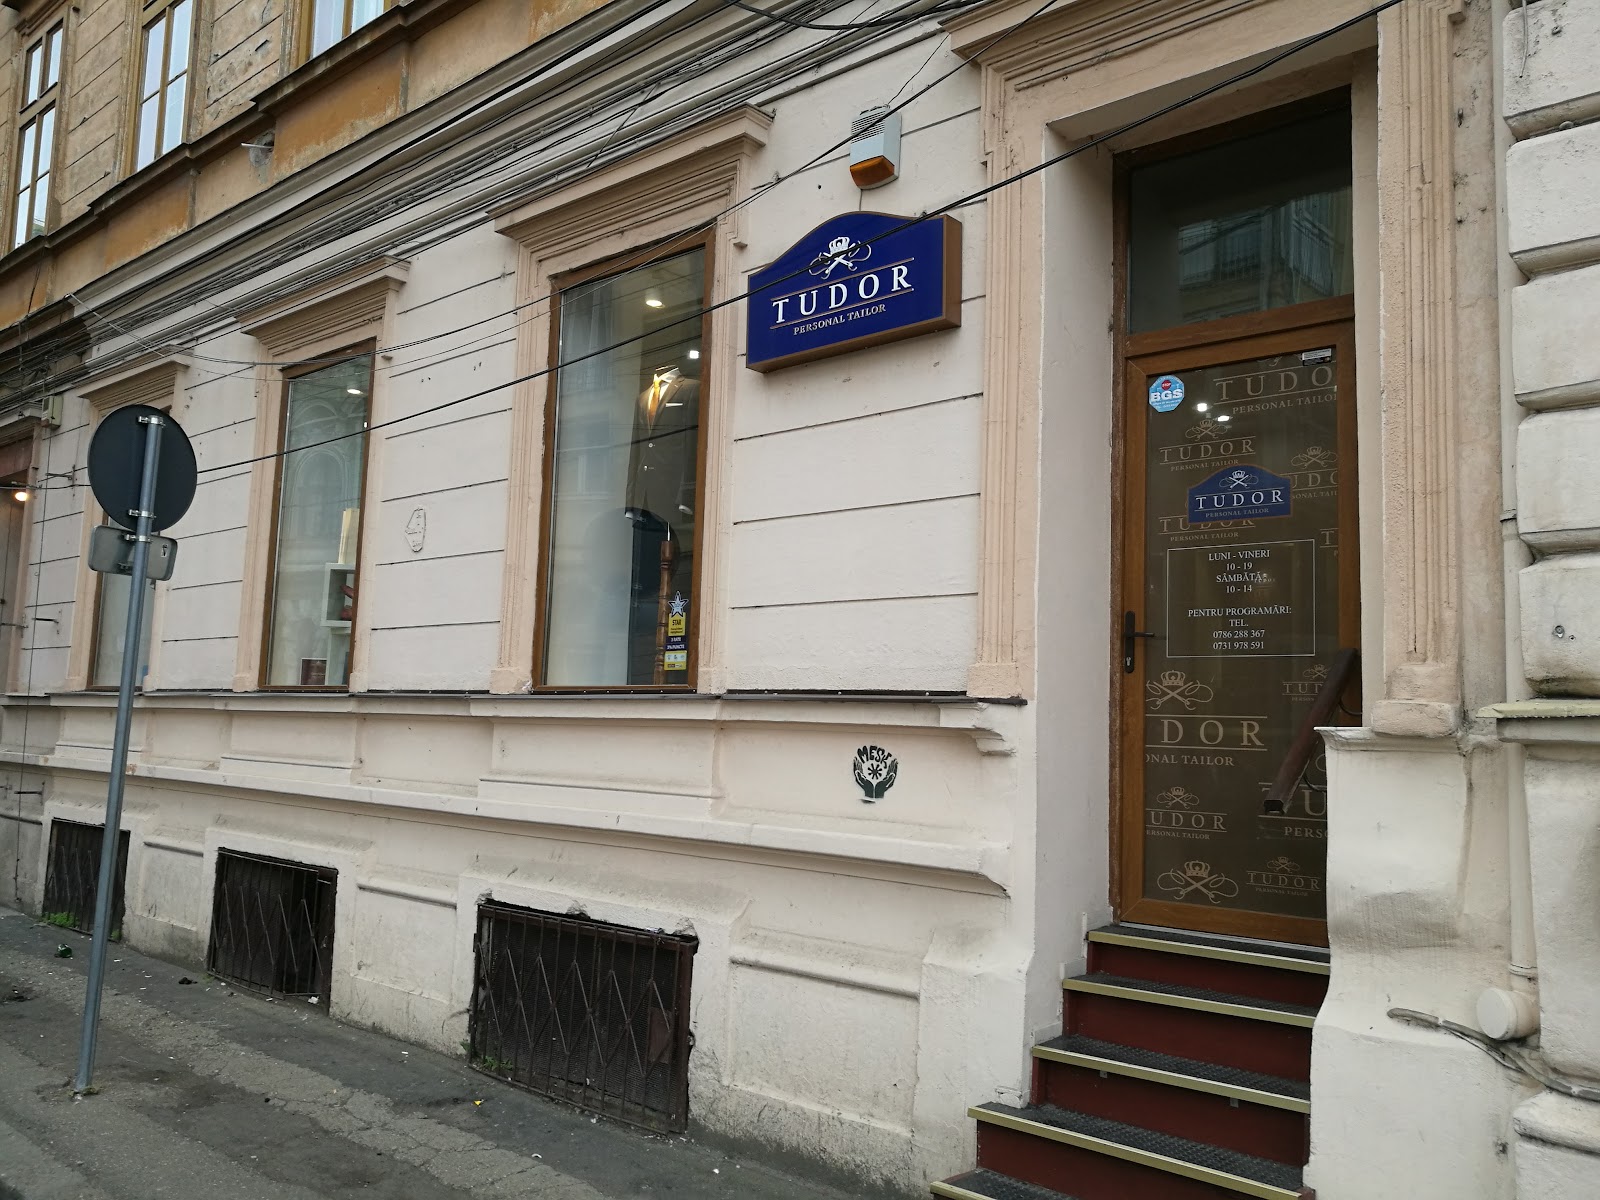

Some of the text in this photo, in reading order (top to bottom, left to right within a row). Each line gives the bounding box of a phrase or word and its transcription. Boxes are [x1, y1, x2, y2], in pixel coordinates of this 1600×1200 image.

[772, 265, 912, 324] TUDOR
[793, 303, 887, 336] PERSONAL TAILOR
[1150, 388, 1184, 403] BGS
[1232, 401, 1294, 415] PERSONAL
[1160, 439, 1255, 462] TUDOR
[1170, 459, 1239, 472] PERSONAL TAILOR
[1195, 489, 1284, 510] TUDOR
[1205, 507, 1270, 518] PERSONAL TAILOR
[1170, 531, 1239, 542] PERSONAL TAILOR
[1208, 552, 1231, 561] LUNI
[1238, 549, 1271, 559] VINERI
[1226, 563, 1236, 571] 10
[1243, 562, 1253, 570] 19
[1216, 571, 1263, 583] SÂMBĂTĂ
[1226, 585, 1236, 593] 10
[1243, 584, 1253, 593] 14
[1188, 605, 1292, 617] PENTRU PROGRAMĂRI:
[1229, 618, 1249, 627] TEL.
[1212, 629, 1265, 639] 0786 288 367
[1212, 641, 1264, 650] 0731 978 591
[1181, 755, 1235, 767] TAILOR
[1182, 832, 1210, 840] TAILOR
[1284, 826, 1327, 839] PERS
[1247, 872, 1320, 890] TUDOR
